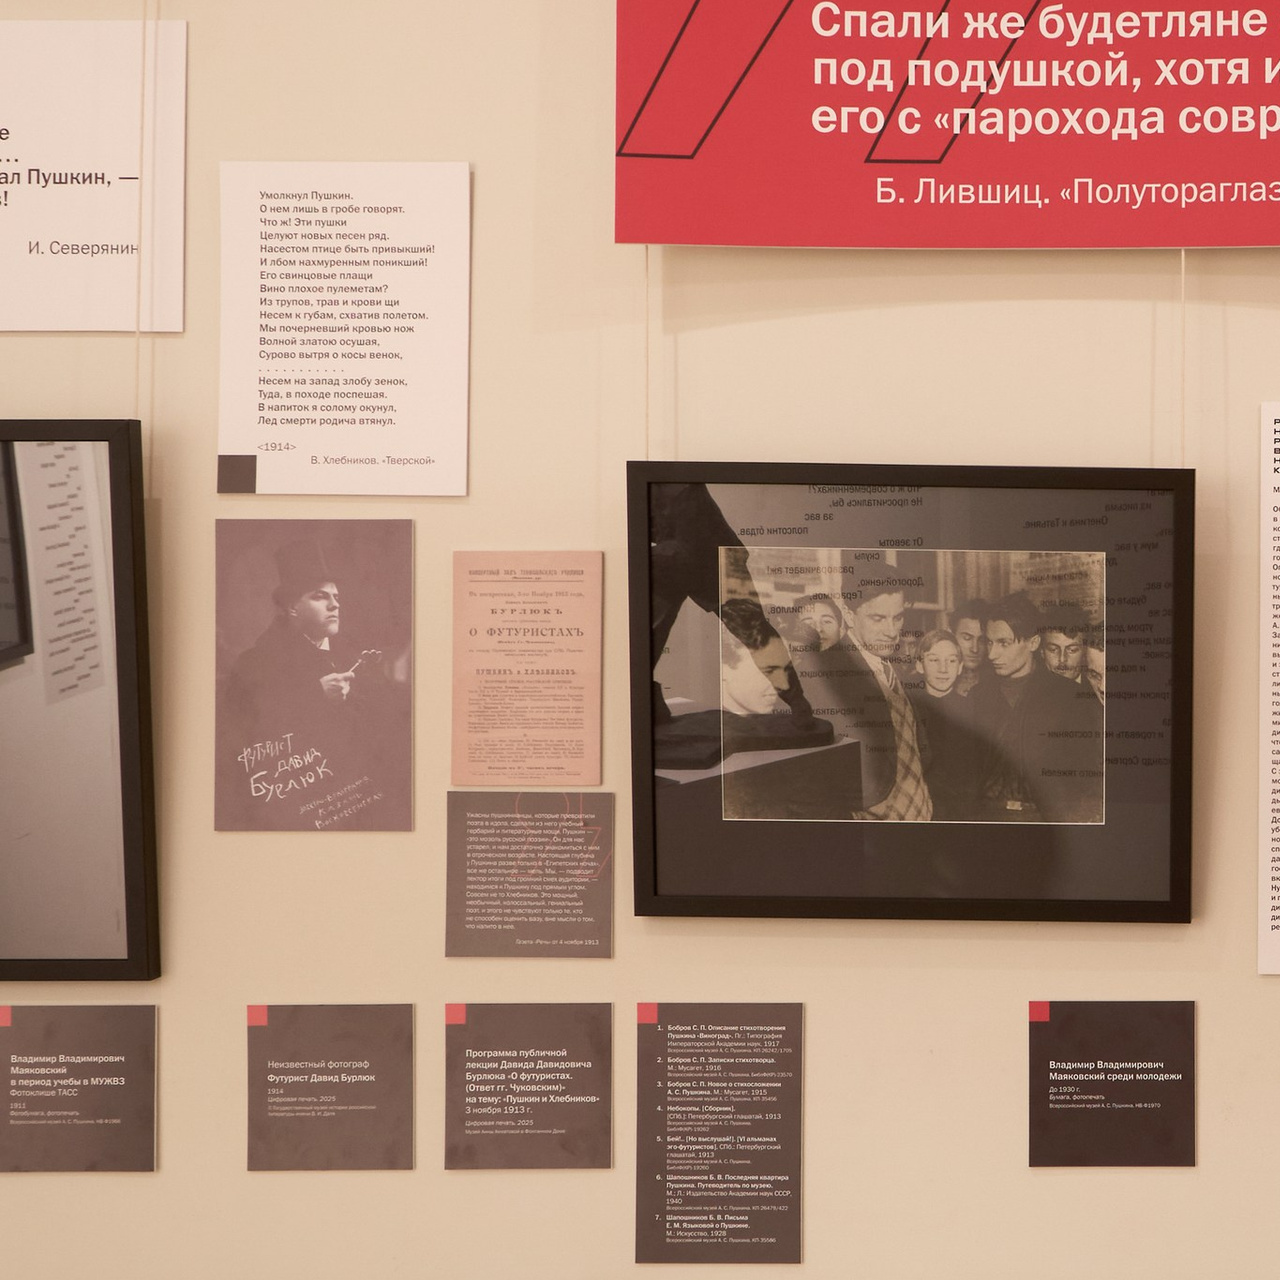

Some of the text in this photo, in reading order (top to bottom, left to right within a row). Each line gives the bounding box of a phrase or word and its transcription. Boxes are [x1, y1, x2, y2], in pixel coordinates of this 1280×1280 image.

[811, 1, 949, 38] Спали
[962, 11, 1025, 39] же
[1039, 3, 1268, 47] будетляне
[814, 58, 894, 92] под
[908, 51, 1141, 95] подушкой,
[1154, 57, 1249, 86] хотя
[811, 105, 885, 134] его
[897, 107, 921, 135] с
[934, 107, 1165, 143] «парохода
[27, 168, 111, 189] Пушкин,
[259, 190, 354, 202] Умолкнул Пушкин.
[877, 177, 905, 203] Б.
[913, 177, 1050, 209] Лившиц.
[259, 203, 405, 215] О нем лишь в гробе говорят.
[28, 240, 45, 255] И.
[257, 441, 297, 452] <1914>
[310, 455, 436, 467] В. Хлебников. «Тверской»
[10, 1054, 125, 1065] Владимир Владимирович
[465, 1048, 567, 1059] Программа публичной
[10, 1065, 67, 1075] Маяковский
[267, 1073, 376, 1084] Футурист Давид Бурлюк
[1049, 1072, 1183, 1082] Маяковский среди молодежи
[465, 1105, 472, 1115] 3
[472, 1105, 502, 1115] ноября
[503, 1105, 525, 1114] 1913
